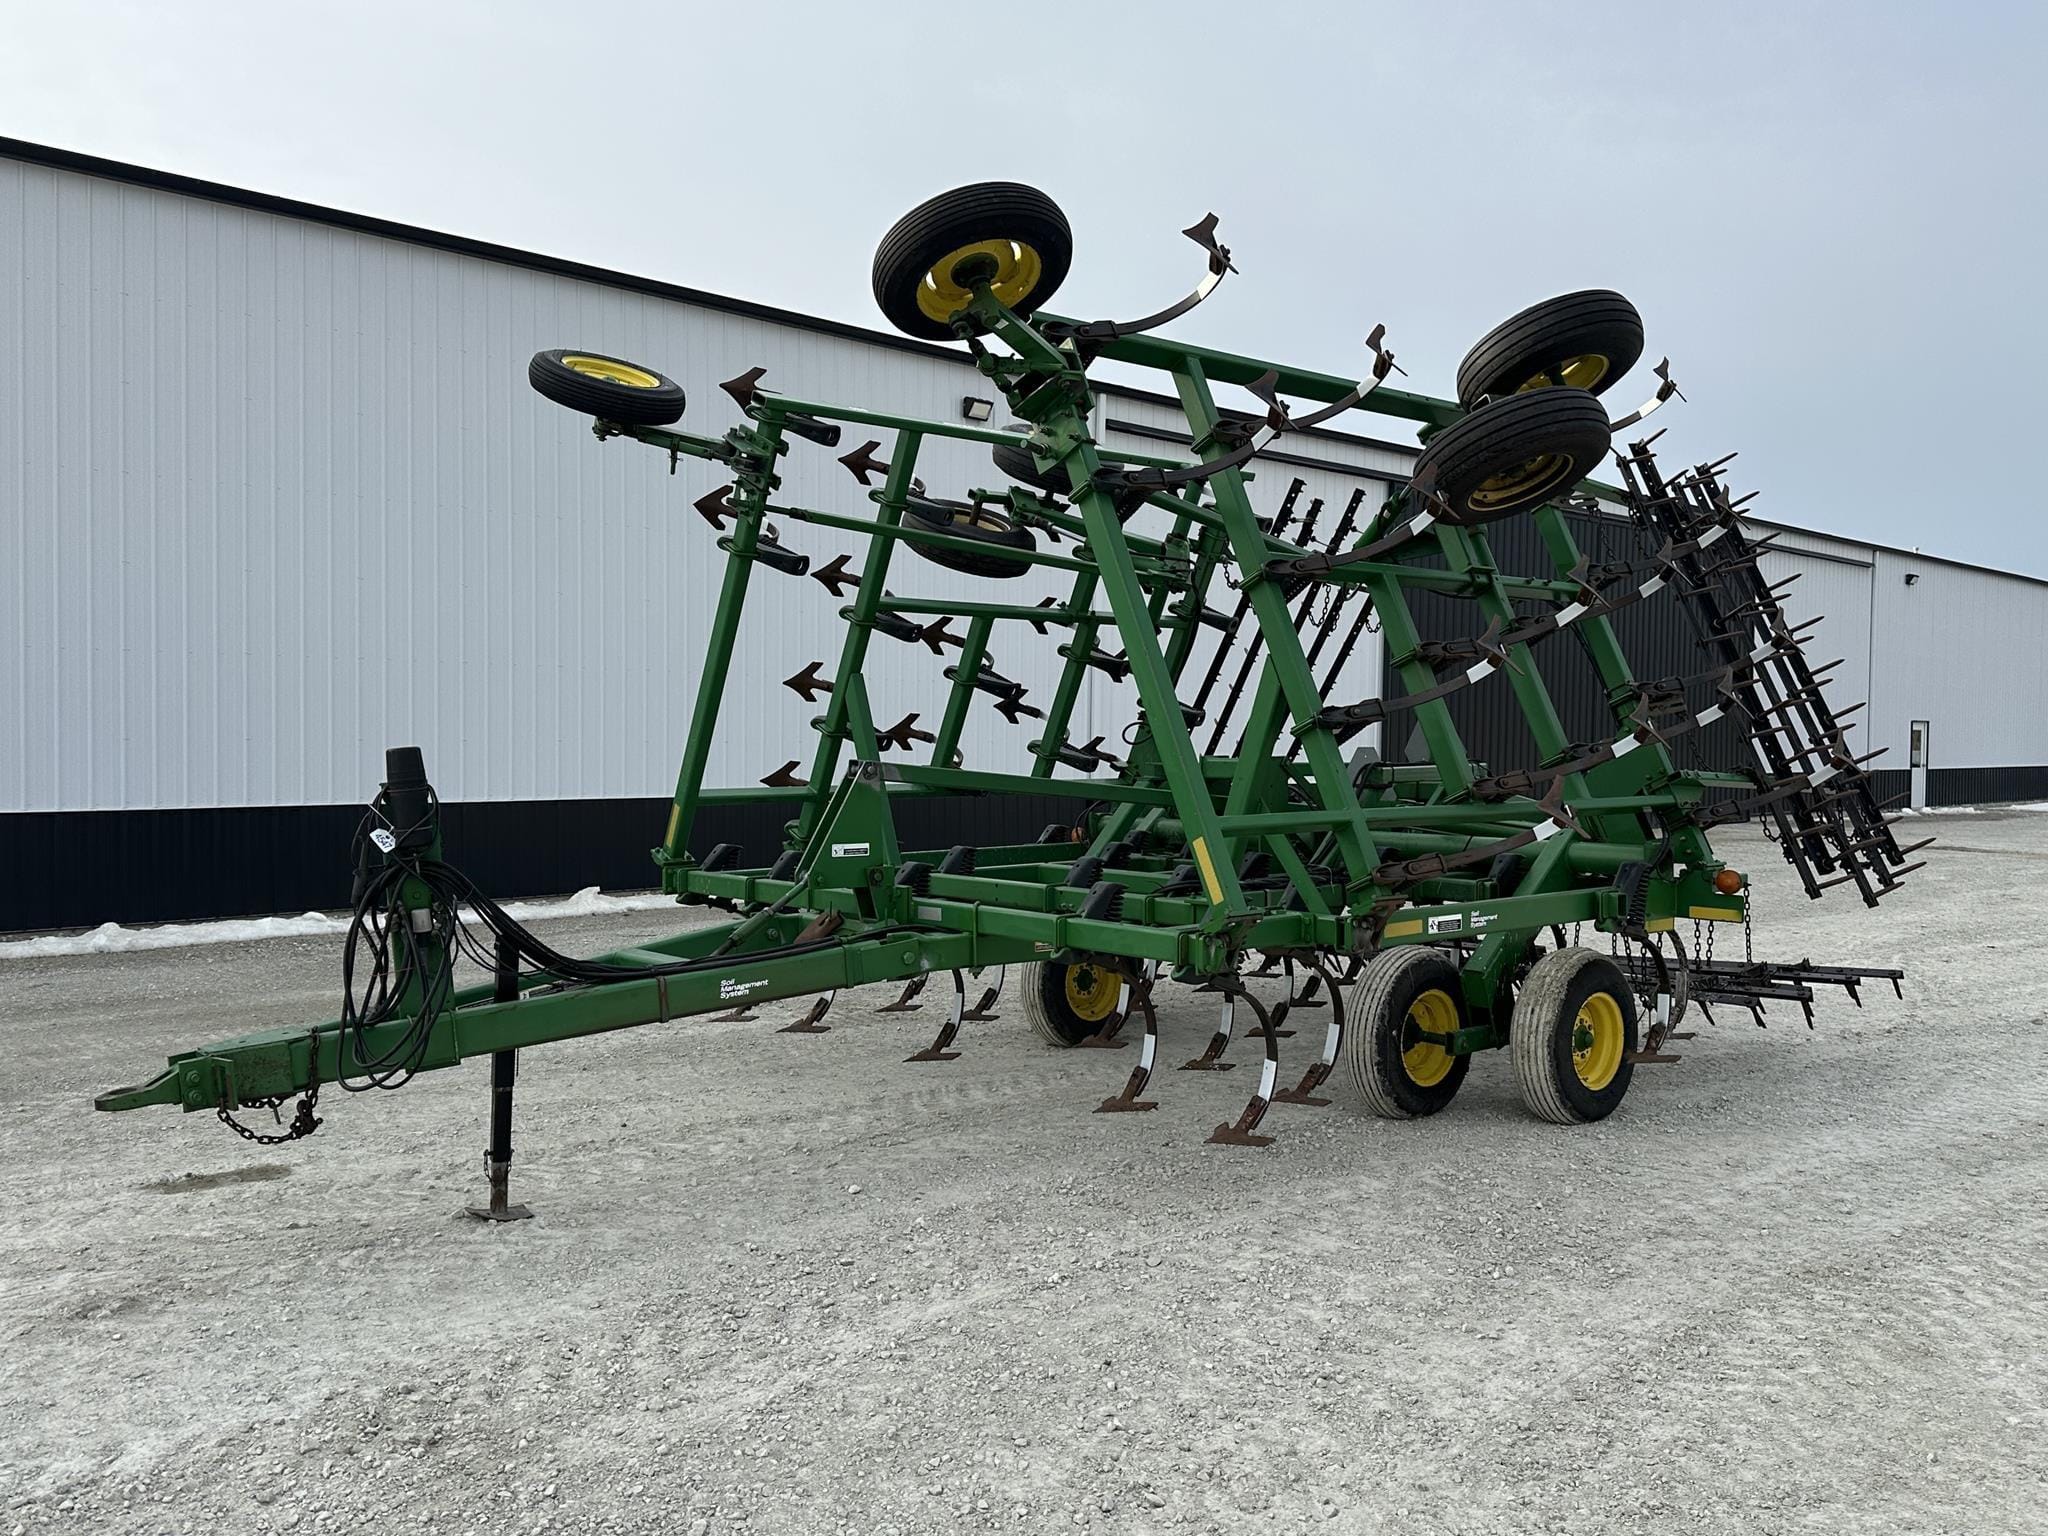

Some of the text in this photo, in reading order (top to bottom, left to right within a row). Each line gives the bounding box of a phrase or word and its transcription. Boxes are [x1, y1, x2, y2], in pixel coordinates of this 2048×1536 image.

[720, 978, 735, 986] Soil
[721, 979, 769, 992] Management
[720, 989, 750, 999] System
